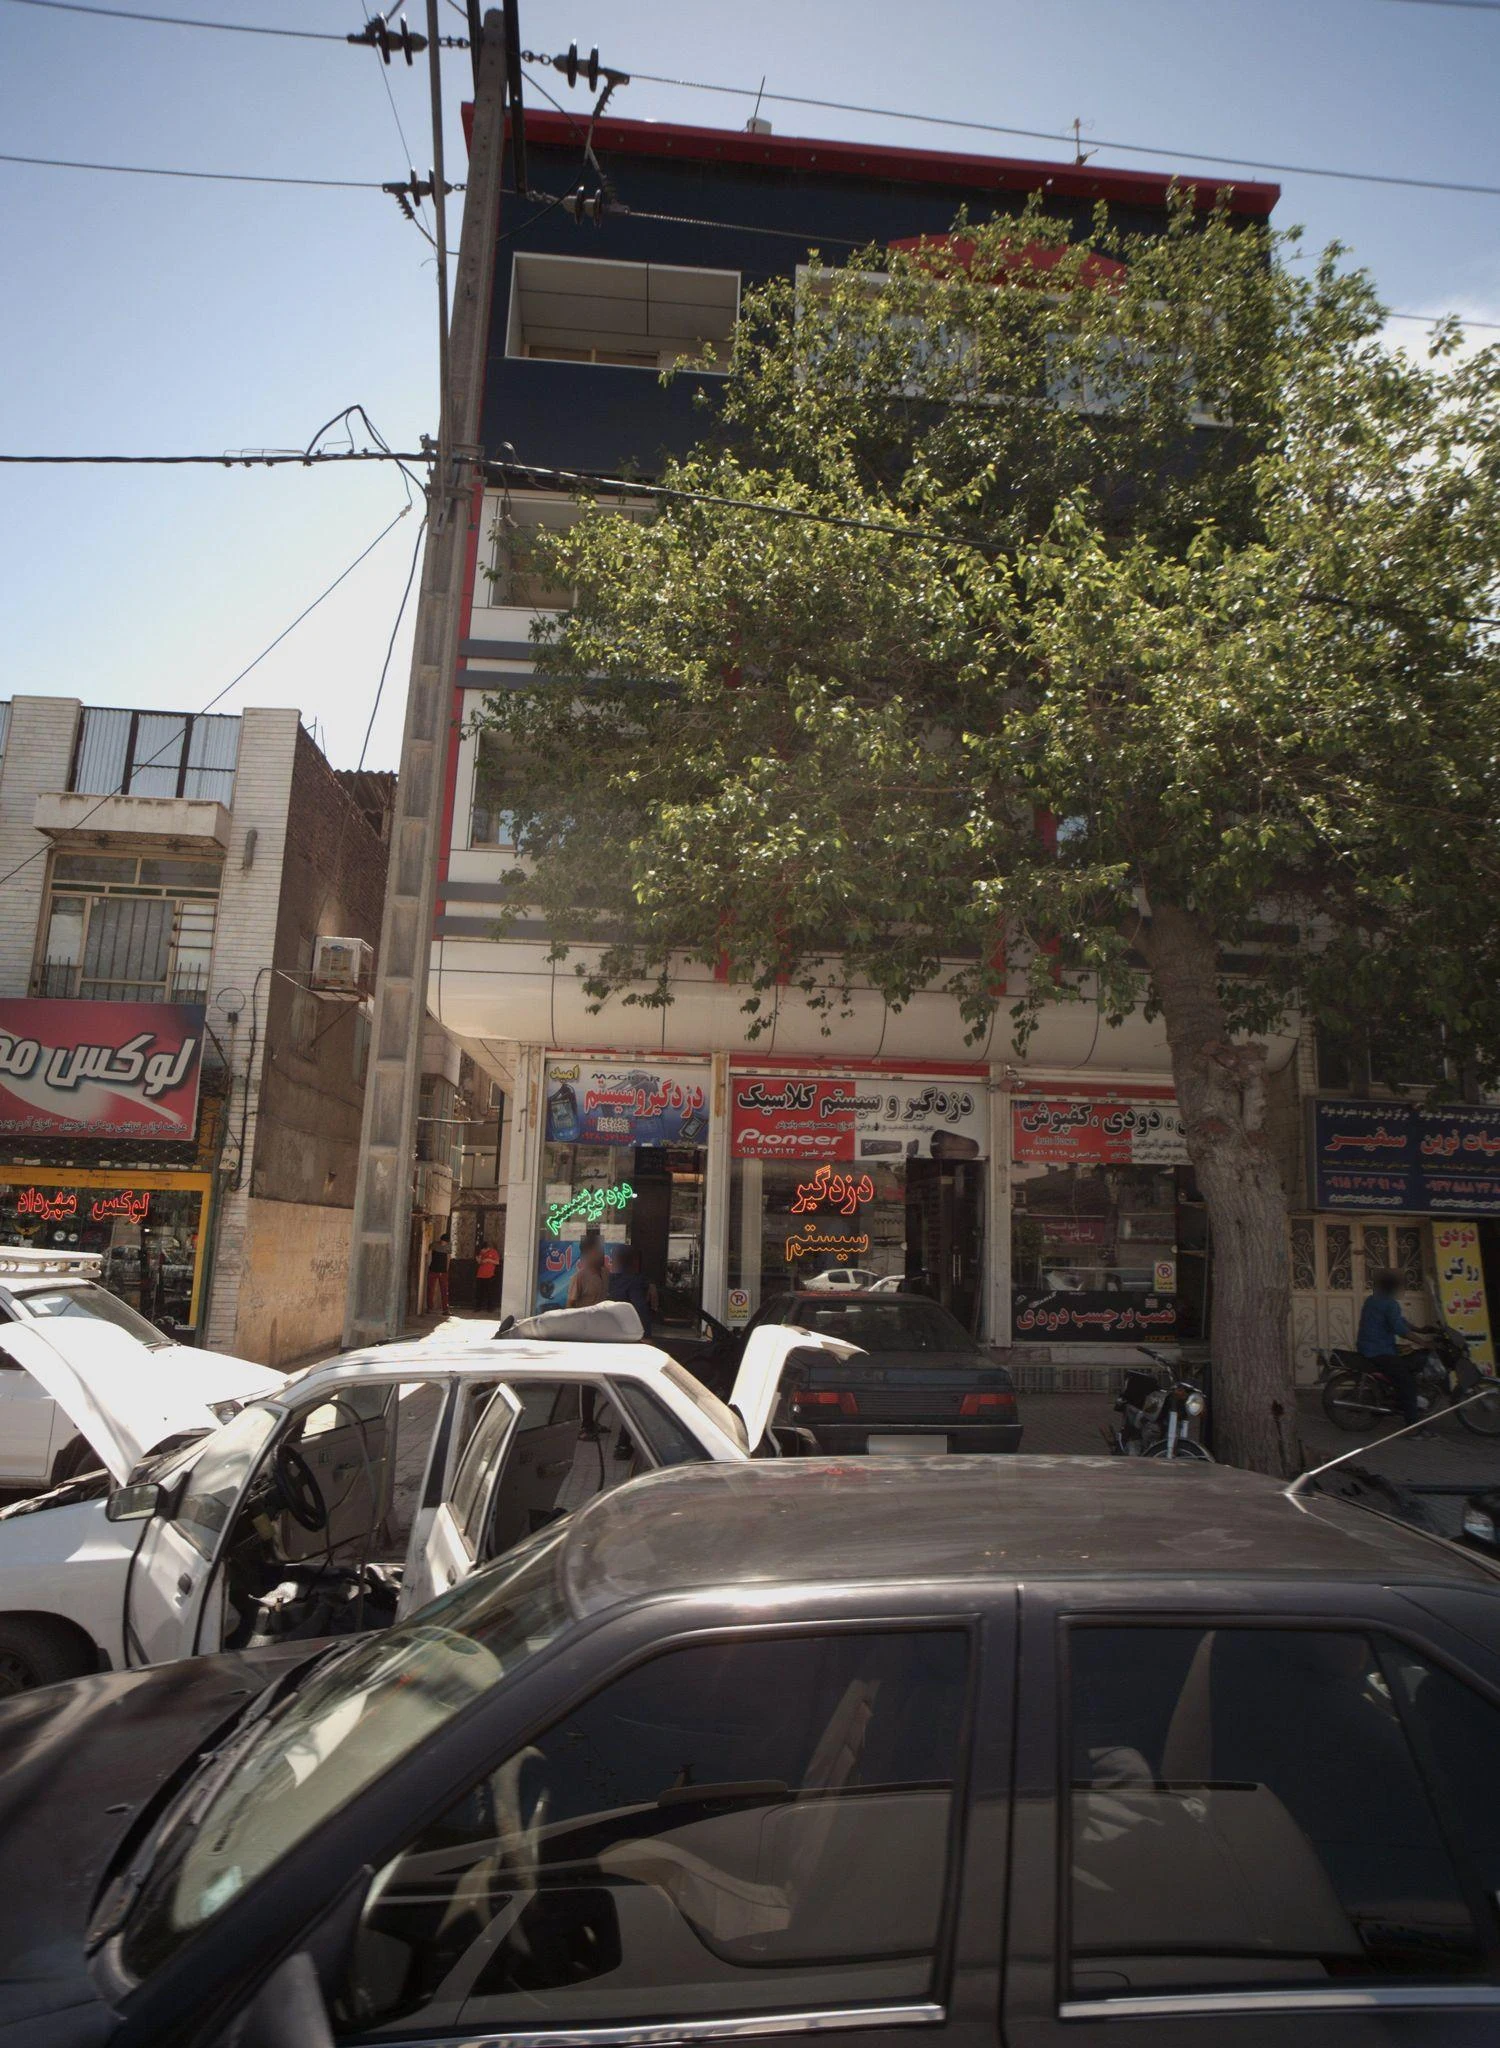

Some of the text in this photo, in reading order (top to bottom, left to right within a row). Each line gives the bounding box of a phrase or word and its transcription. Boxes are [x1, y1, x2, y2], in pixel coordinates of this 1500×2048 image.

[44, 1032, 197, 1096] لوکس
[550, 1064, 581, 1081] امید
[584, 1079, 636, 1115] سیستم
[645, 1078, 705, 1119] دزدگیر
[737, 1082, 974, 1123] دزدگیر و سیستم کلاسیک
[1021, 1103, 1093, 1135] کفپوش
[736, 1128, 843, 1146] Pioneer
[1325, 1126, 1408, 1151] سفیر
[1420, 1129, 1460, 1156] نوین
[17, 1187, 150, 1224] لوکس مهرداد
[791, 1164, 874, 1215] دزدگیر
[546, 1183, 633, 1235] دزدگیر سیستم
[785, 1224, 869, 1262] سیستم
[1439, 1229, 1475, 1249] دودی
[1016, 1307, 1070, 1331] دودی
[1135, 1302, 1177, 1328] نصب
